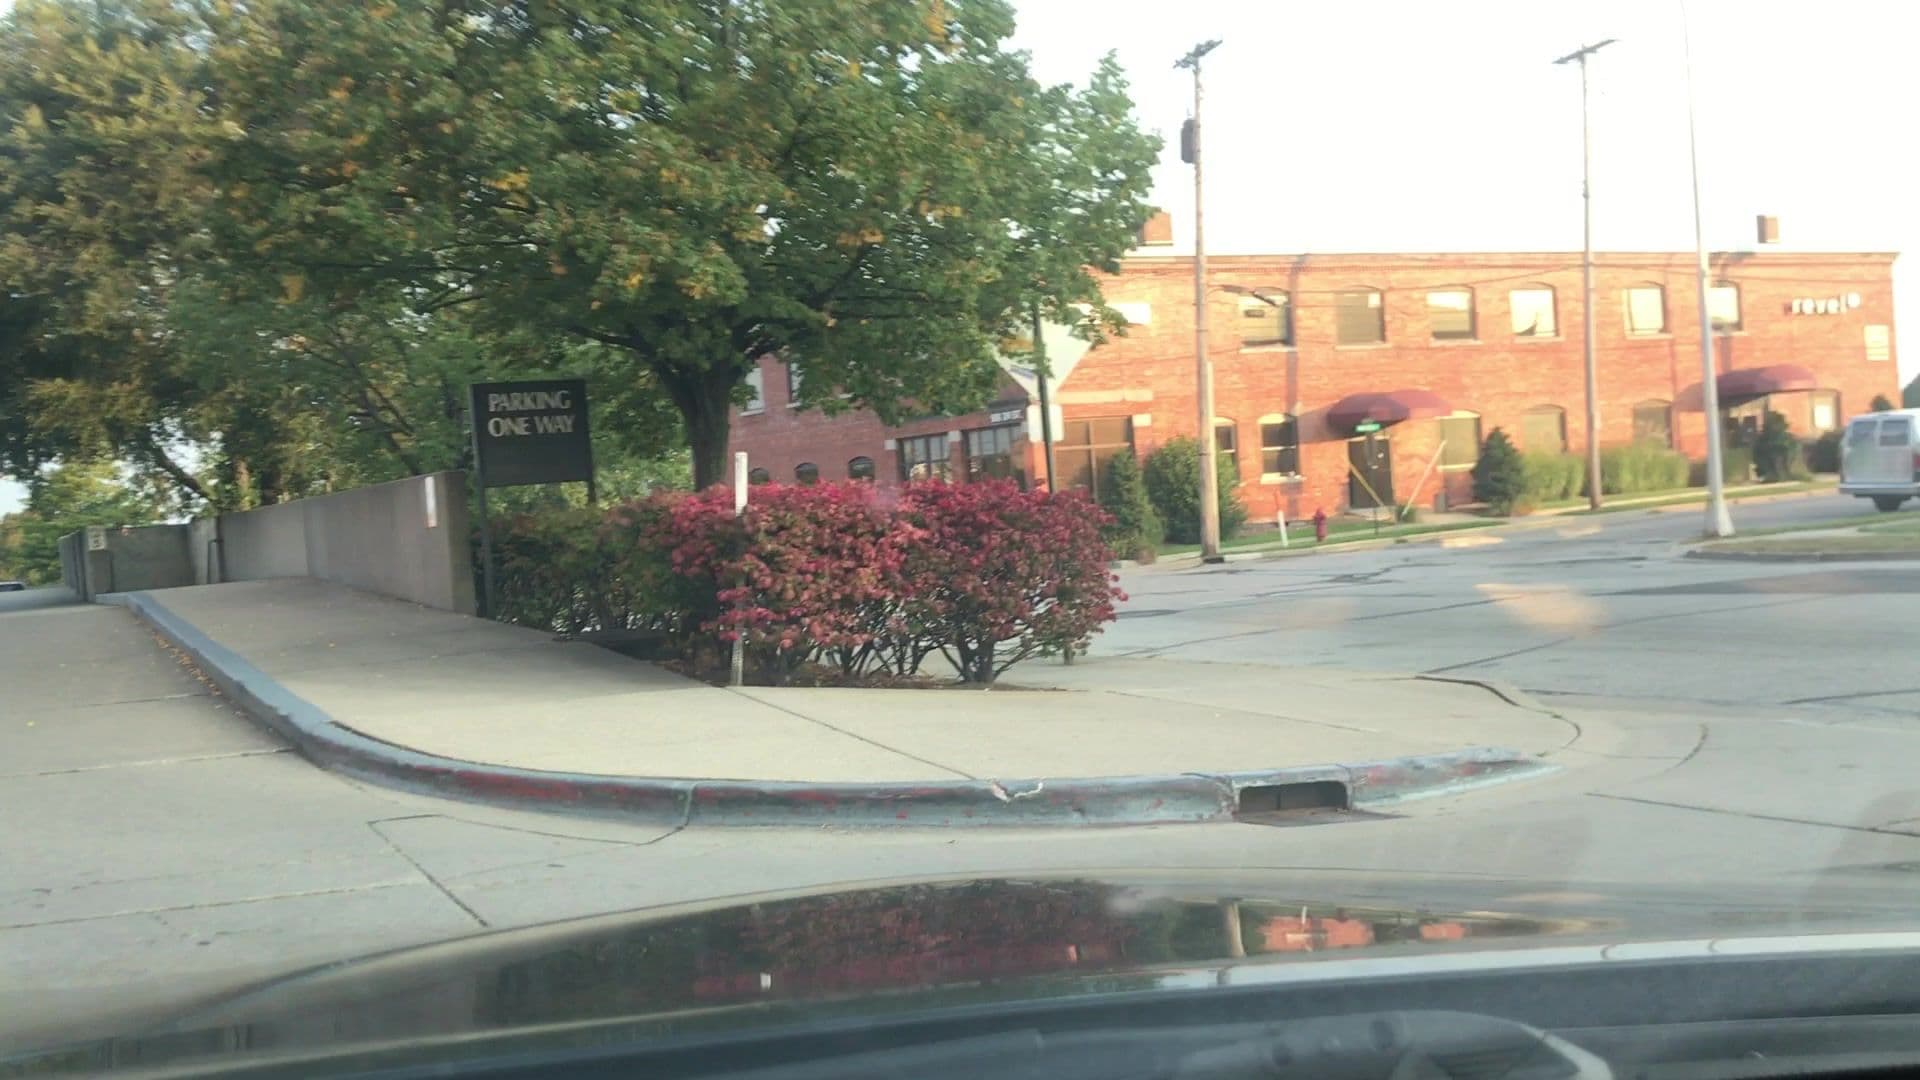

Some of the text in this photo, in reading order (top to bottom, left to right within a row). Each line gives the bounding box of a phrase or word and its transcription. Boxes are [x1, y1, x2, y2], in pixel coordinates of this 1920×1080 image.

[487, 390, 572, 412] PARKING
[488, 414, 576, 437] ONE WAY
